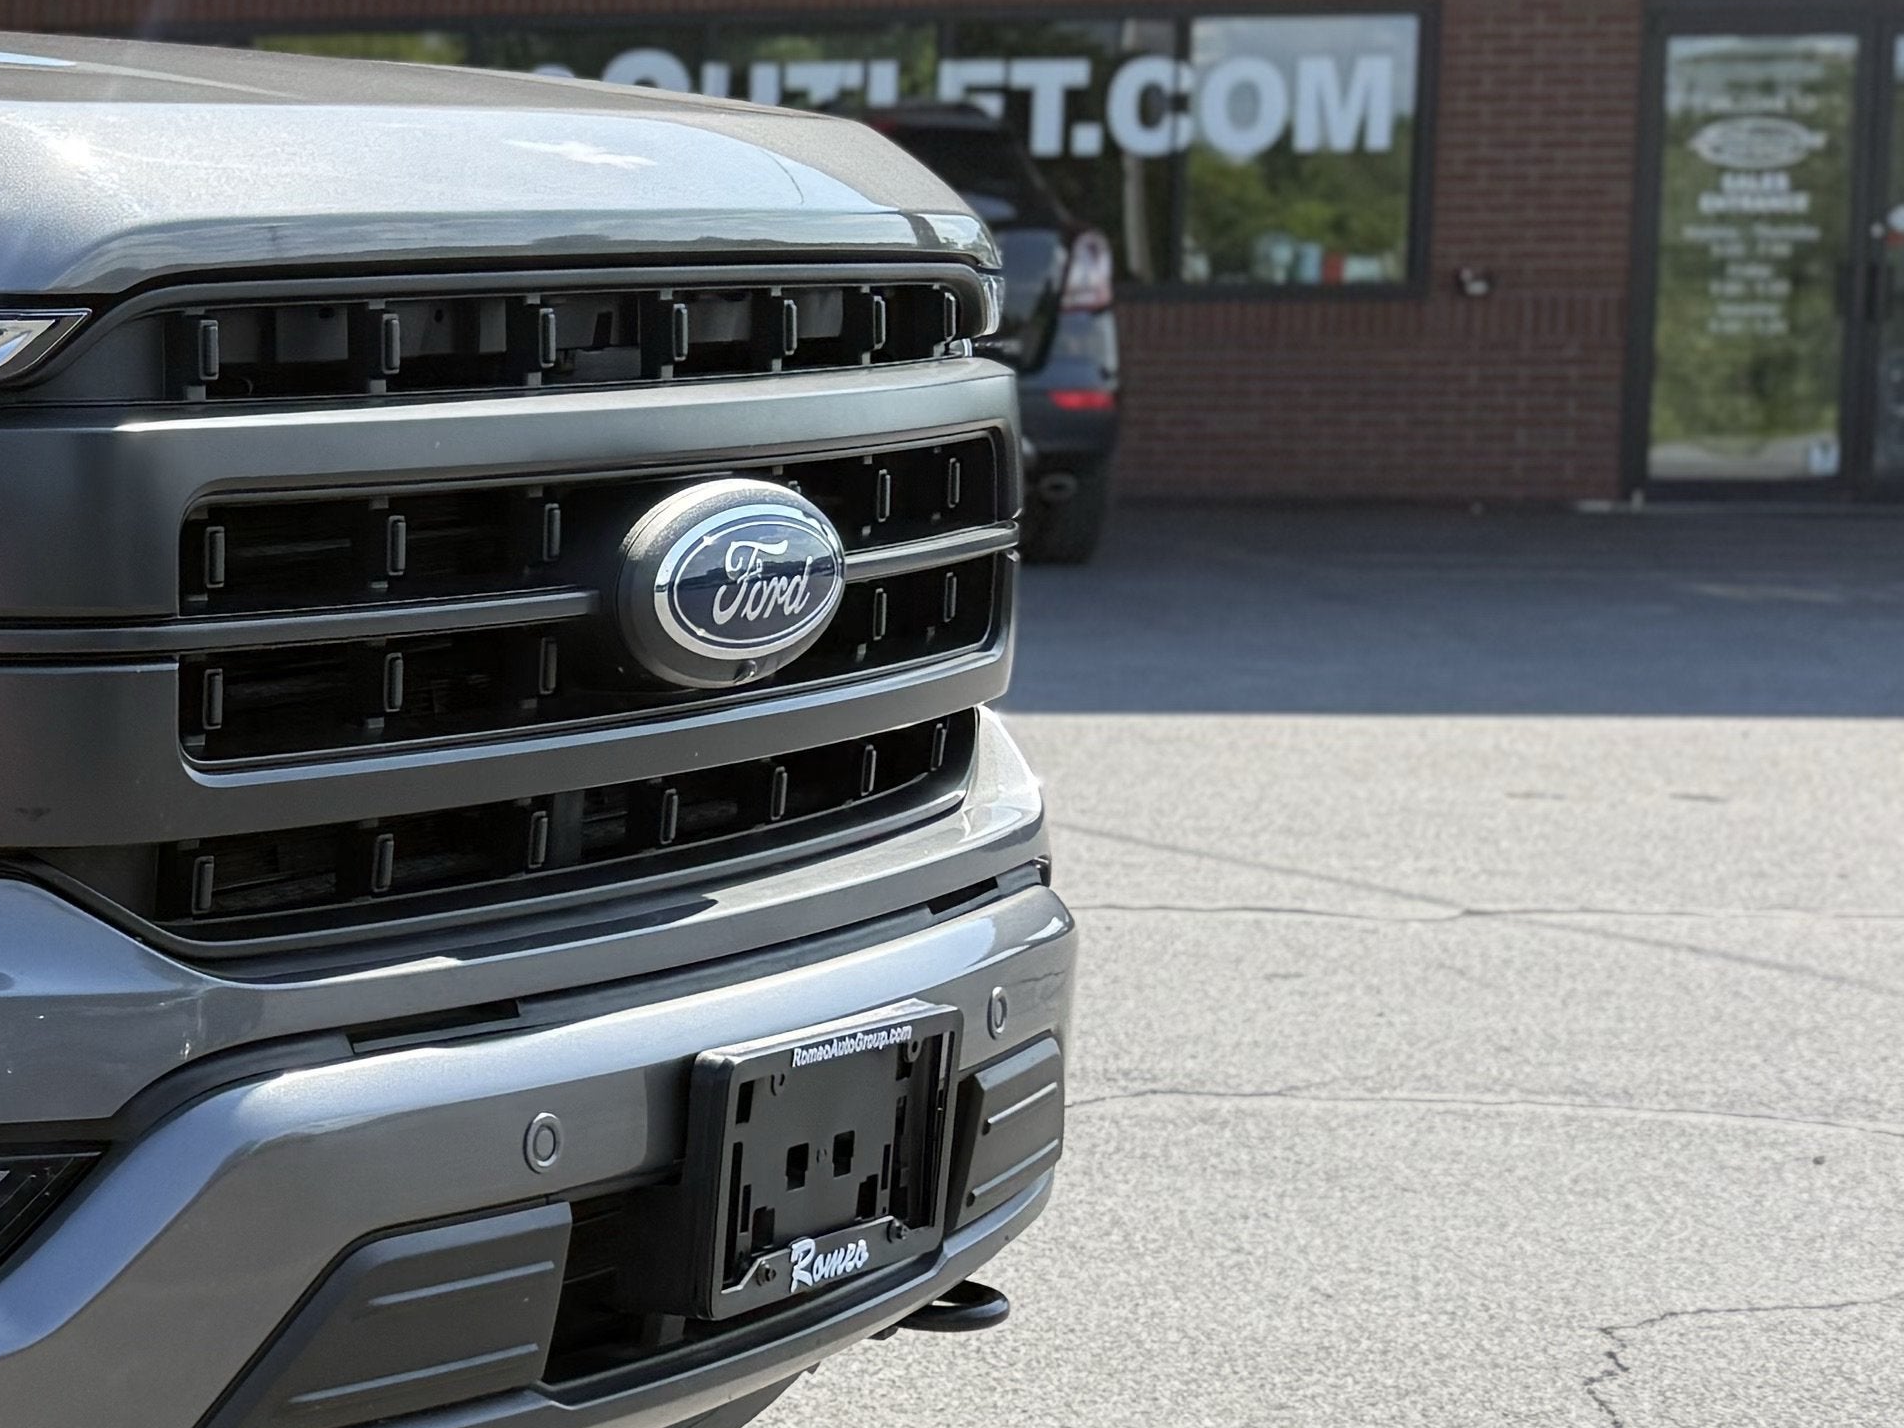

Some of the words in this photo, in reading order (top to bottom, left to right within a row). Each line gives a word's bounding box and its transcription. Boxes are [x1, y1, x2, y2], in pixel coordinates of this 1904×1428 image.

[712, 539, 813, 625] Ford
[792, 1025, 913, 1068] RomeoAutoGroup.com
[790, 1237, 871, 1293] Romeo
